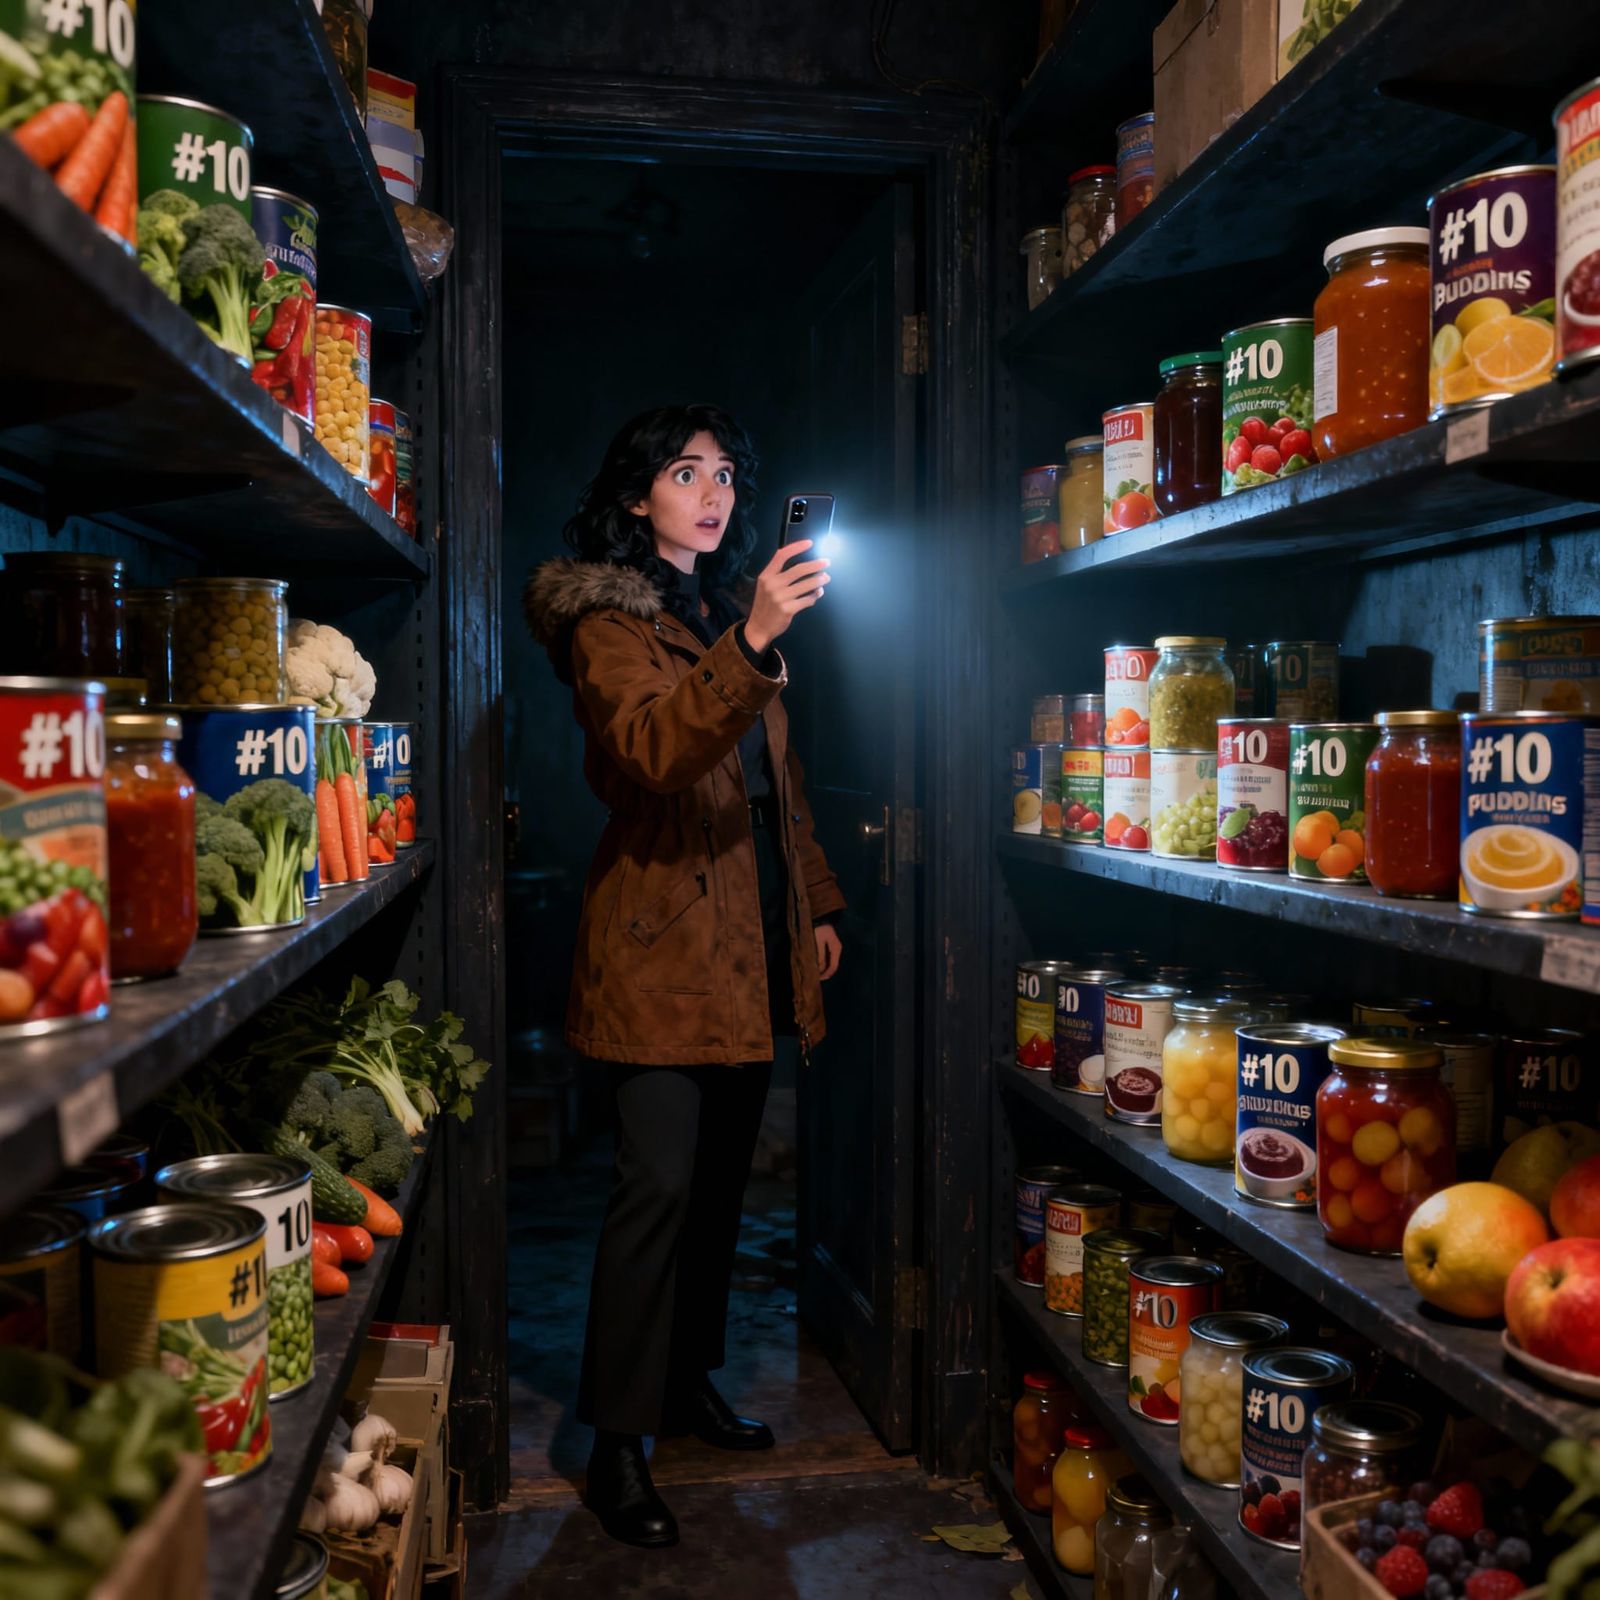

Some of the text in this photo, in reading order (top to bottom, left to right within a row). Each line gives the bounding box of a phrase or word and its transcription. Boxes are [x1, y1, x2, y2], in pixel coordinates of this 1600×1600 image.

[171, 132, 250, 202] #10
[1439, 188, 1529, 266] #10
[1226, 339, 1284, 387] #10
[17, 709, 105, 779] #10
[234, 725, 307, 776] #10
[1292, 736, 1347, 777] #10
[1467, 731, 1553, 785] #10
[1241, 1053, 1301, 1094] #10
[1518, 1055, 1582, 1093] #10
[278, 1199, 310, 1252] 10
[1133, 1290, 1179, 1329] #10
[1246, 1387, 1306, 1434] #10
